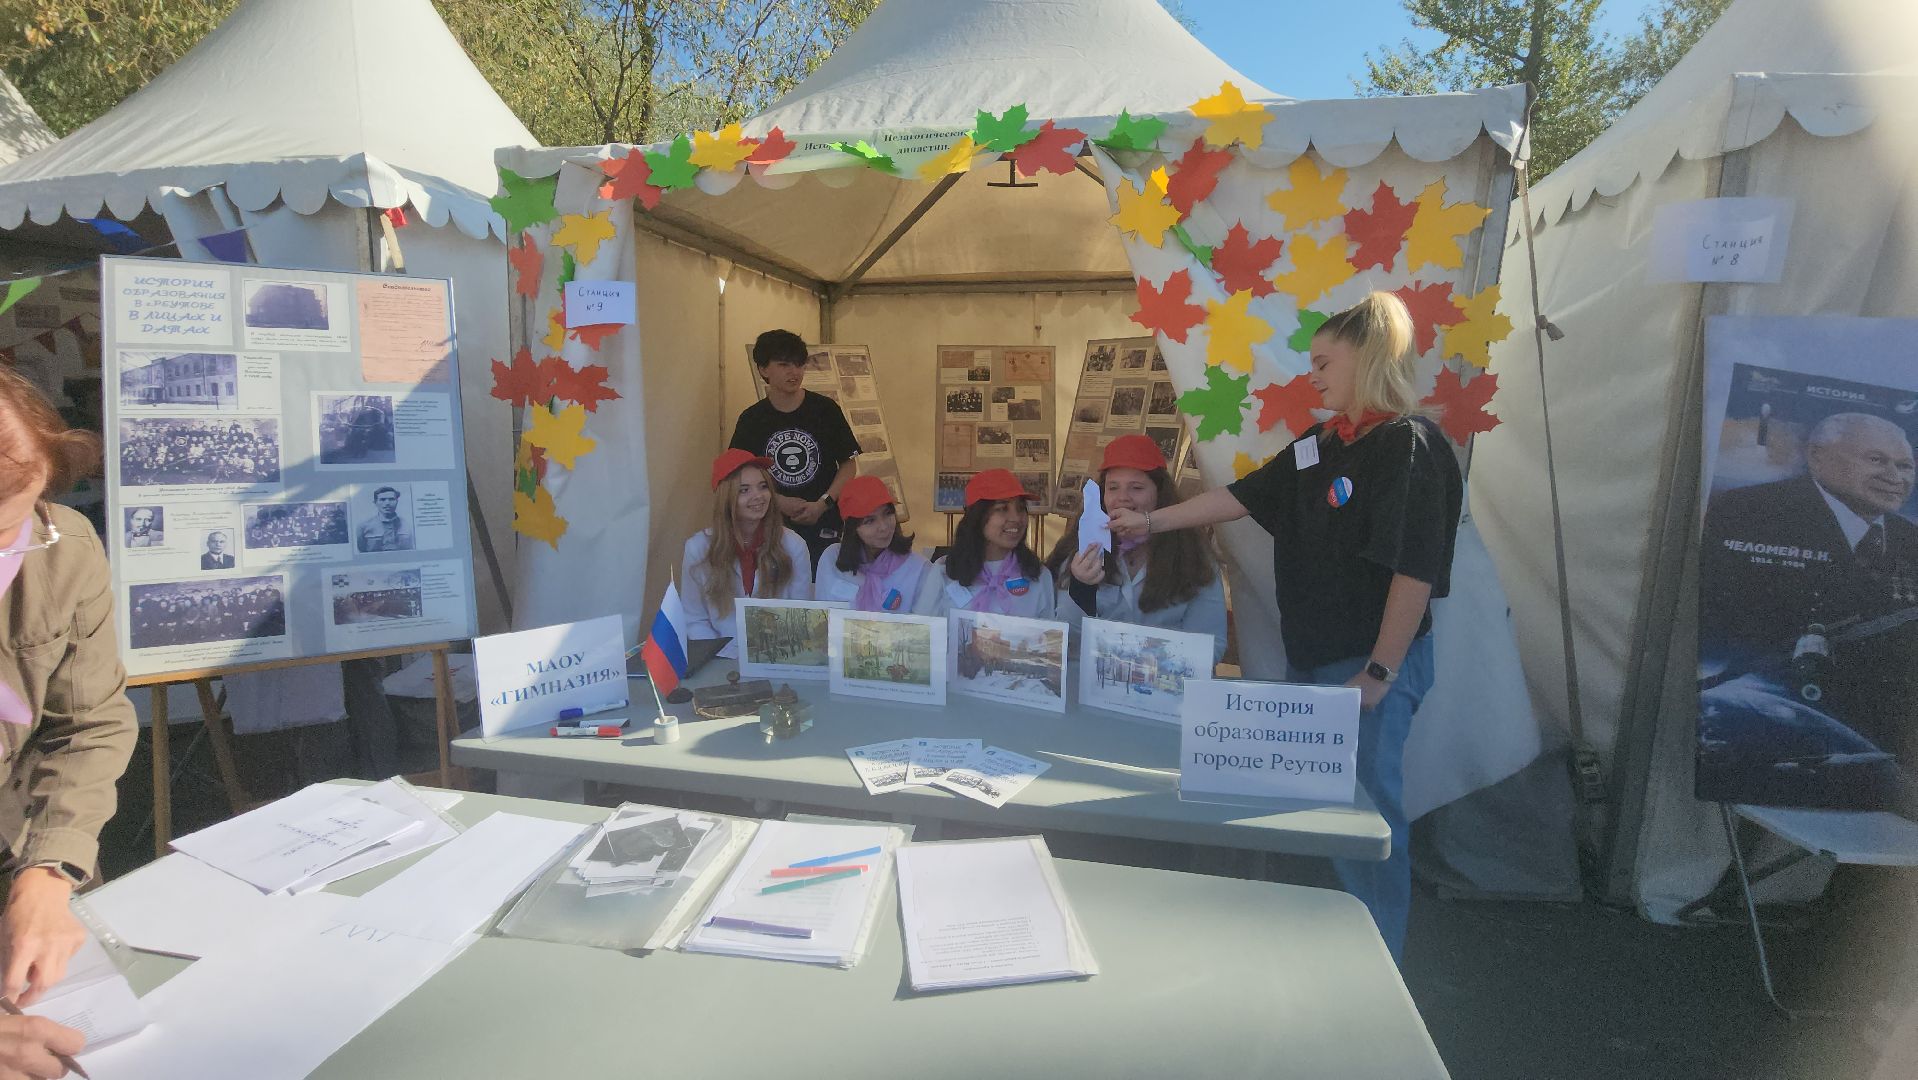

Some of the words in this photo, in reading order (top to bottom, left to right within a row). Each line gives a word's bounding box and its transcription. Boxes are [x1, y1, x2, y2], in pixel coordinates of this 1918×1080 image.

[1703, 234, 1764, 250] Станция
[134, 277, 215, 288] ИСТОРИЯ
[122, 288, 226, 299] ОБРАЗОВАНИЯ
[578, 287, 620, 297] Станция
[129, 311, 139, 320] В
[145, 311, 205, 321] ЛИЦАХ
[141, 324, 210, 334] ДАТАХ
[1806, 385, 1866, 400] ИСТОРИЯ
[1724, 539, 1799, 558] ЧЕЛОМЕЙ
[526, 652, 585, 675] МАОУ
[490, 668, 620, 705] «ГИМНАЗИЯ»
[1226, 693, 1314, 717] История
[1194, 722, 1325, 745] образования
[1333, 733, 1344, 745] в
[1194, 752, 1263, 771] городе
[1271, 753, 1342, 775] Реутов
